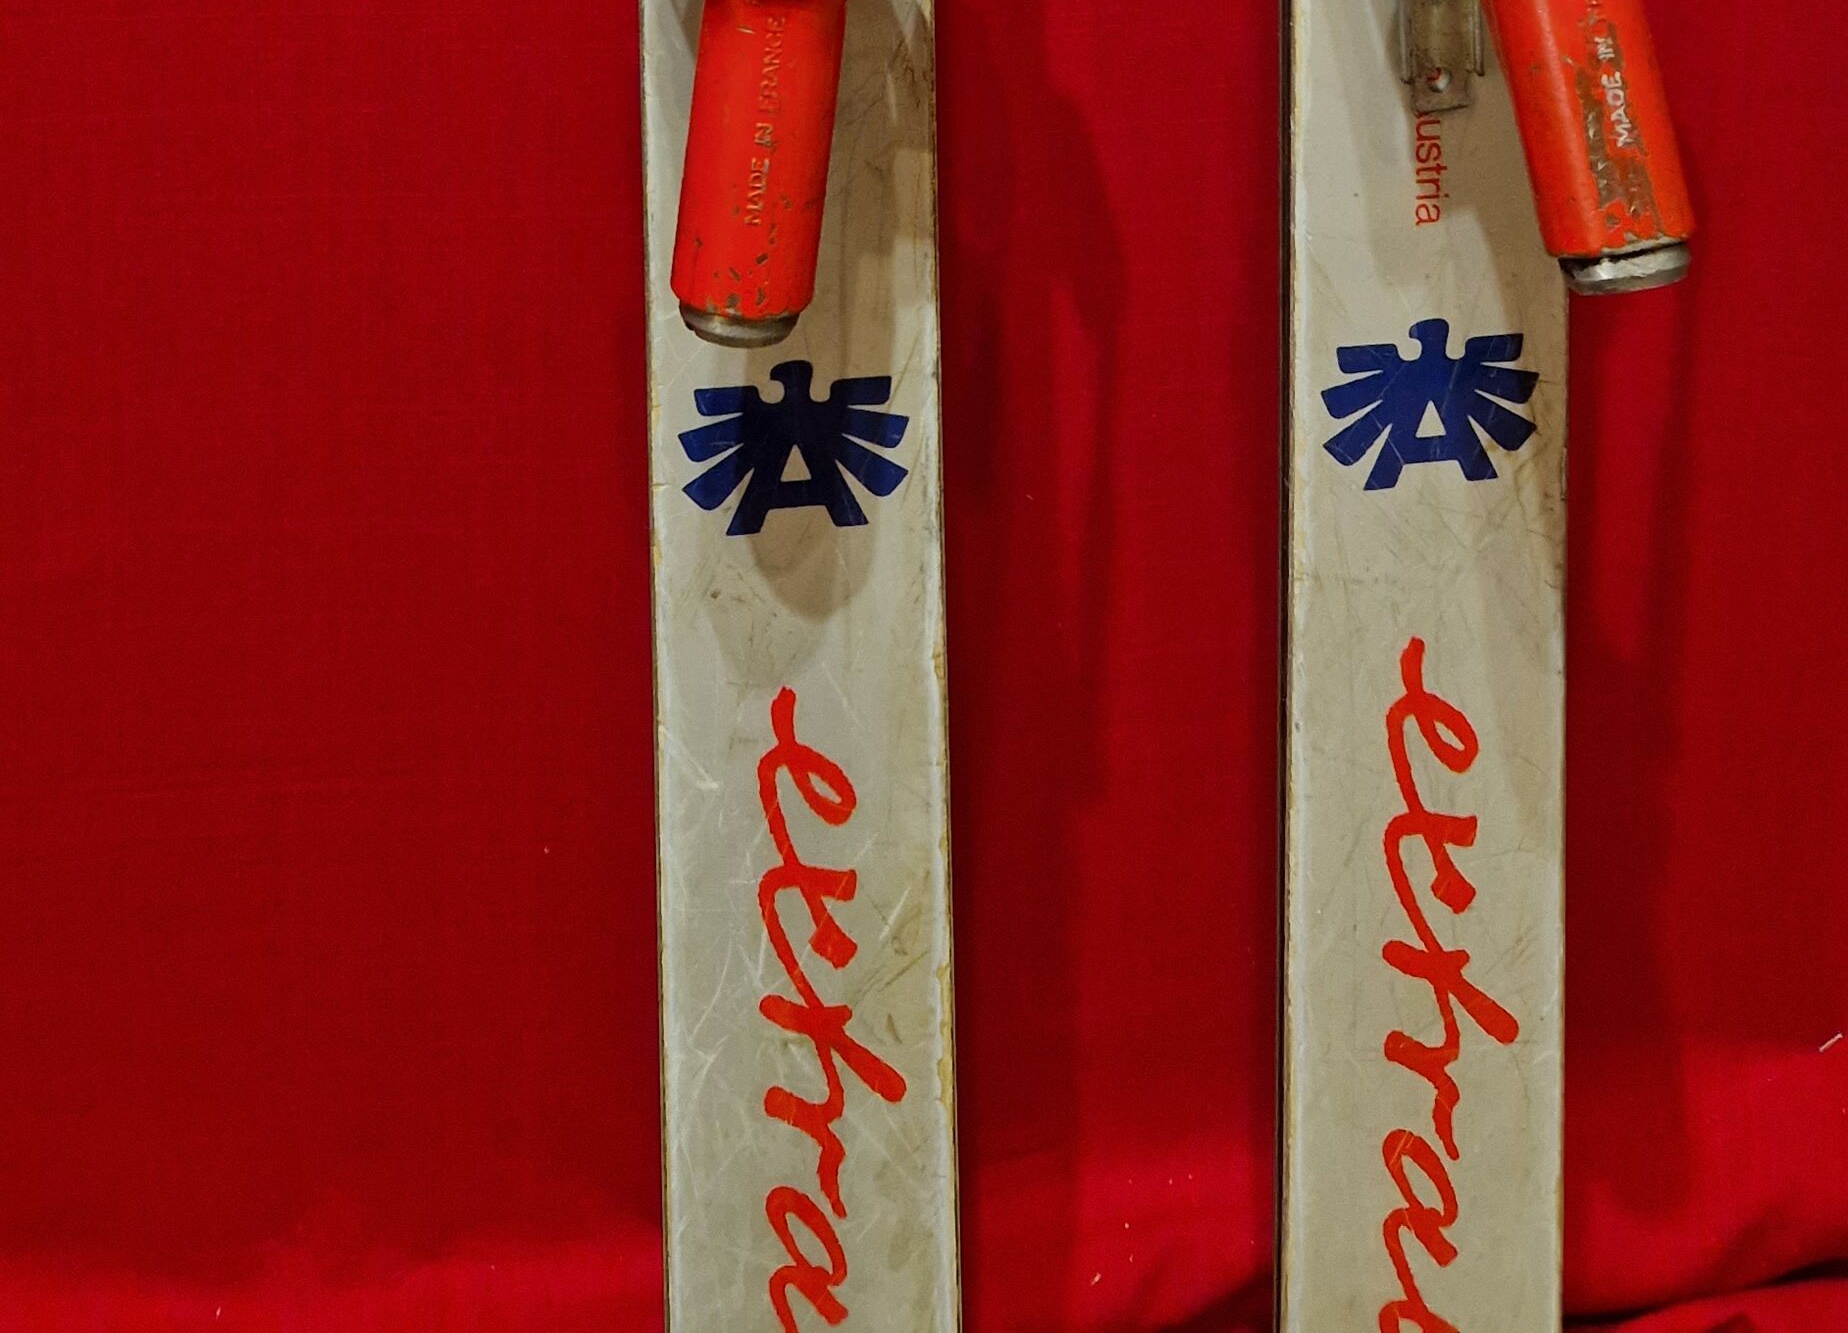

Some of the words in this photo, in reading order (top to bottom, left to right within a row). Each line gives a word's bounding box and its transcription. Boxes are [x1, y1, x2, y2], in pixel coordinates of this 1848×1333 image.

[756, 15, 786, 111] FRANCE
[1592, 33, 1616, 63] IN
[752, 120, 774, 145] IN
[1599, 71, 1635, 148] MADE
[743, 157, 770, 226] MADE
[1412, 112, 1447, 227] ustria
